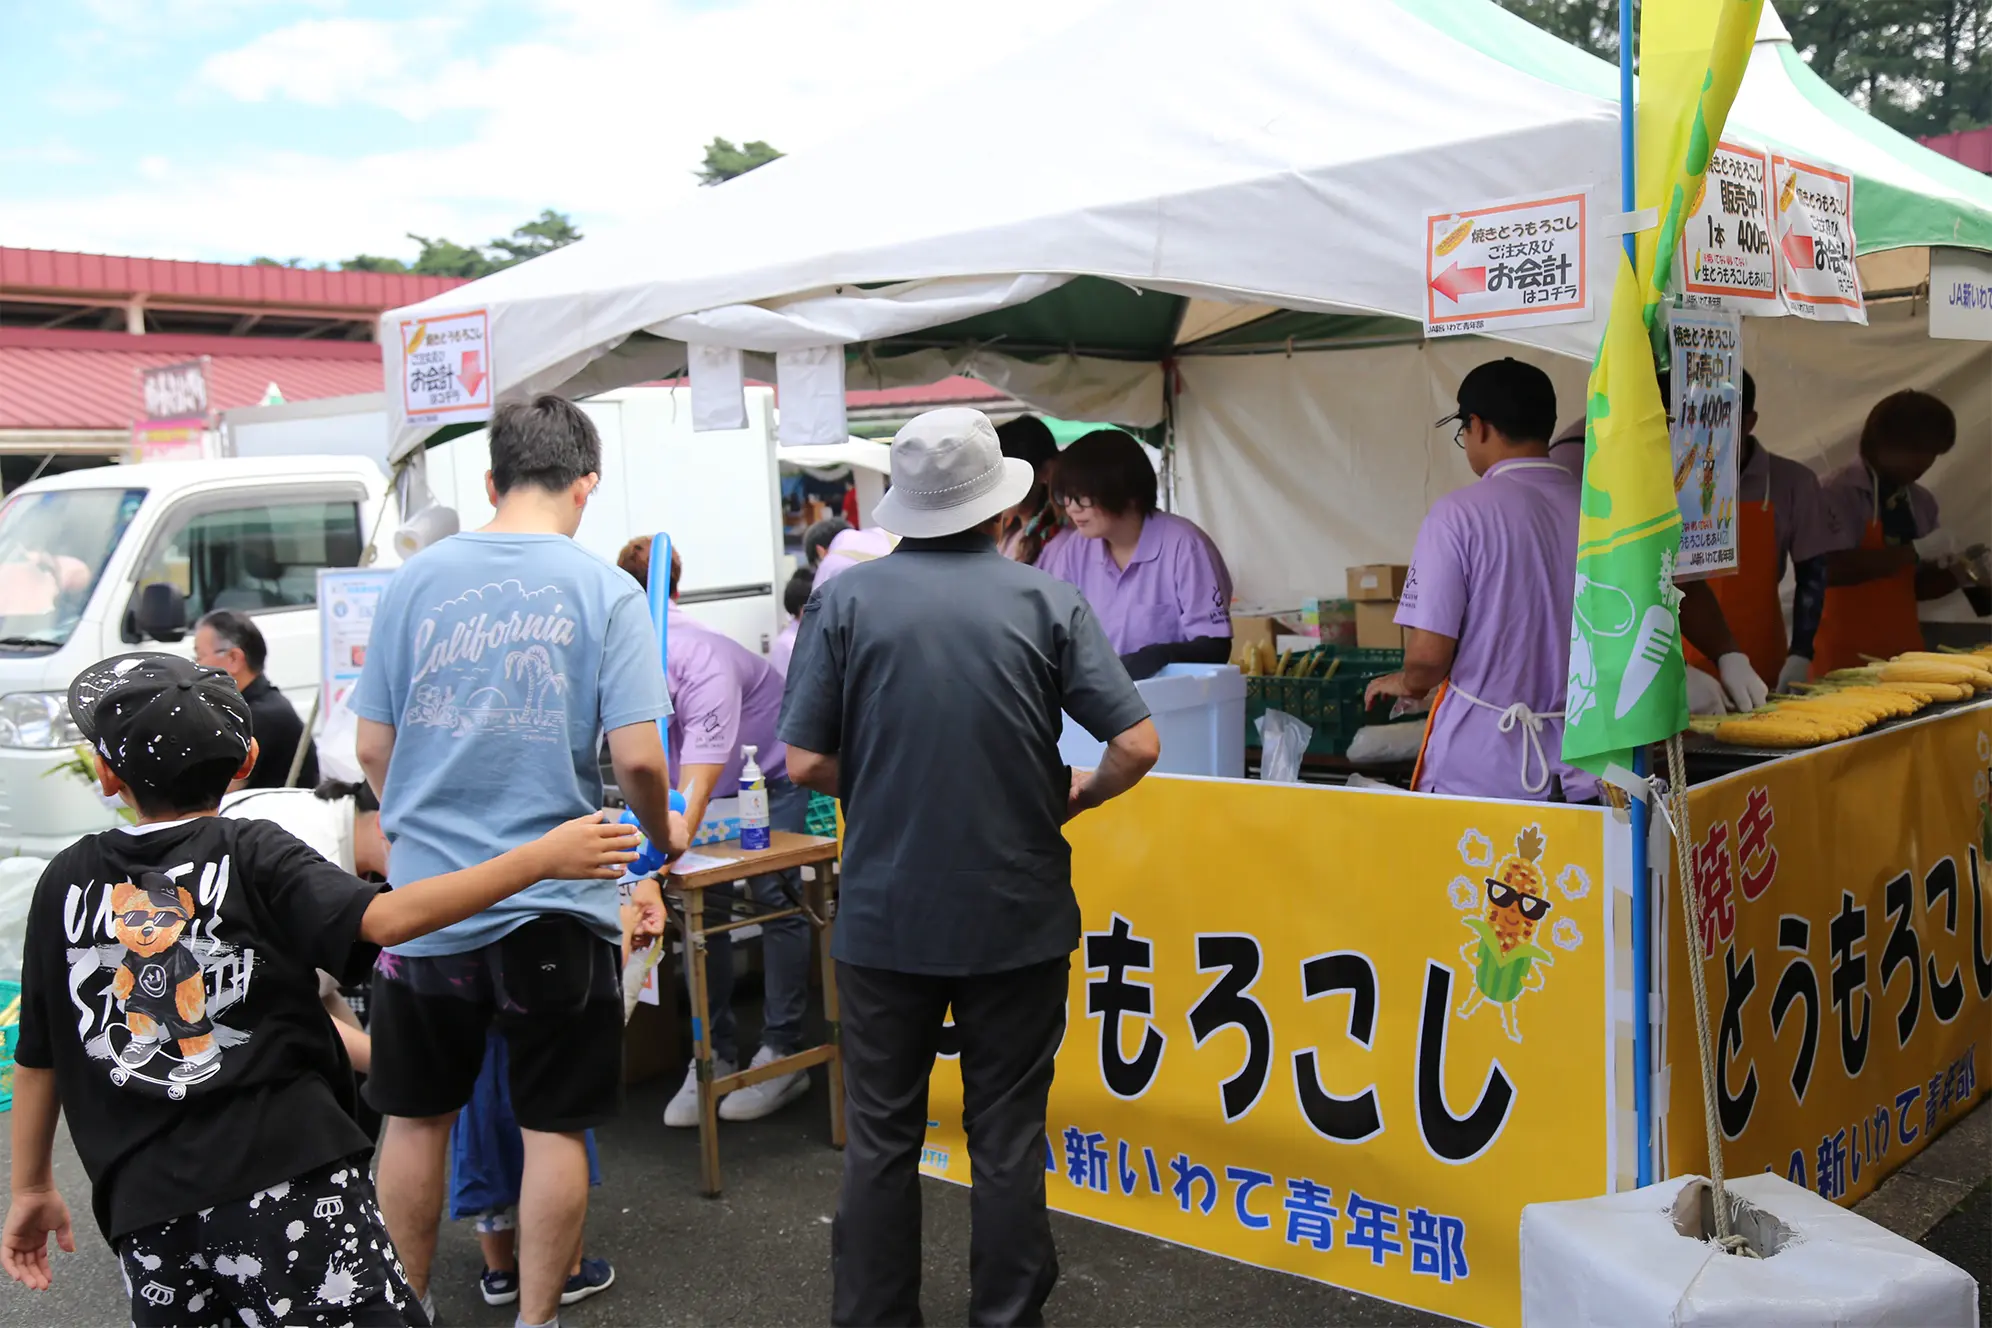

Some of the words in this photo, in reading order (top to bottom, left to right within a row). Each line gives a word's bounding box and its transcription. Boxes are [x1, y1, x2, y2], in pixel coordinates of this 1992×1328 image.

[1471, 216, 1579, 244] 焼きとうもろこし
[1707, 214, 1726, 249] 1本
[1737, 219, 1770, 255] 400円
[1488, 238, 1556, 260] ご注文及び
[1487, 253, 1573, 292] お会計
[1523, 284, 1578, 304] はコチラ
[1673, 325, 1736, 349] 焼きとうもろこし
[411, 363, 455, 393] お会計
[411, 603, 576, 684] California
[1690, 785, 1779, 960] 焼き
[1715, 842, 1992, 1142] とうもろこし
